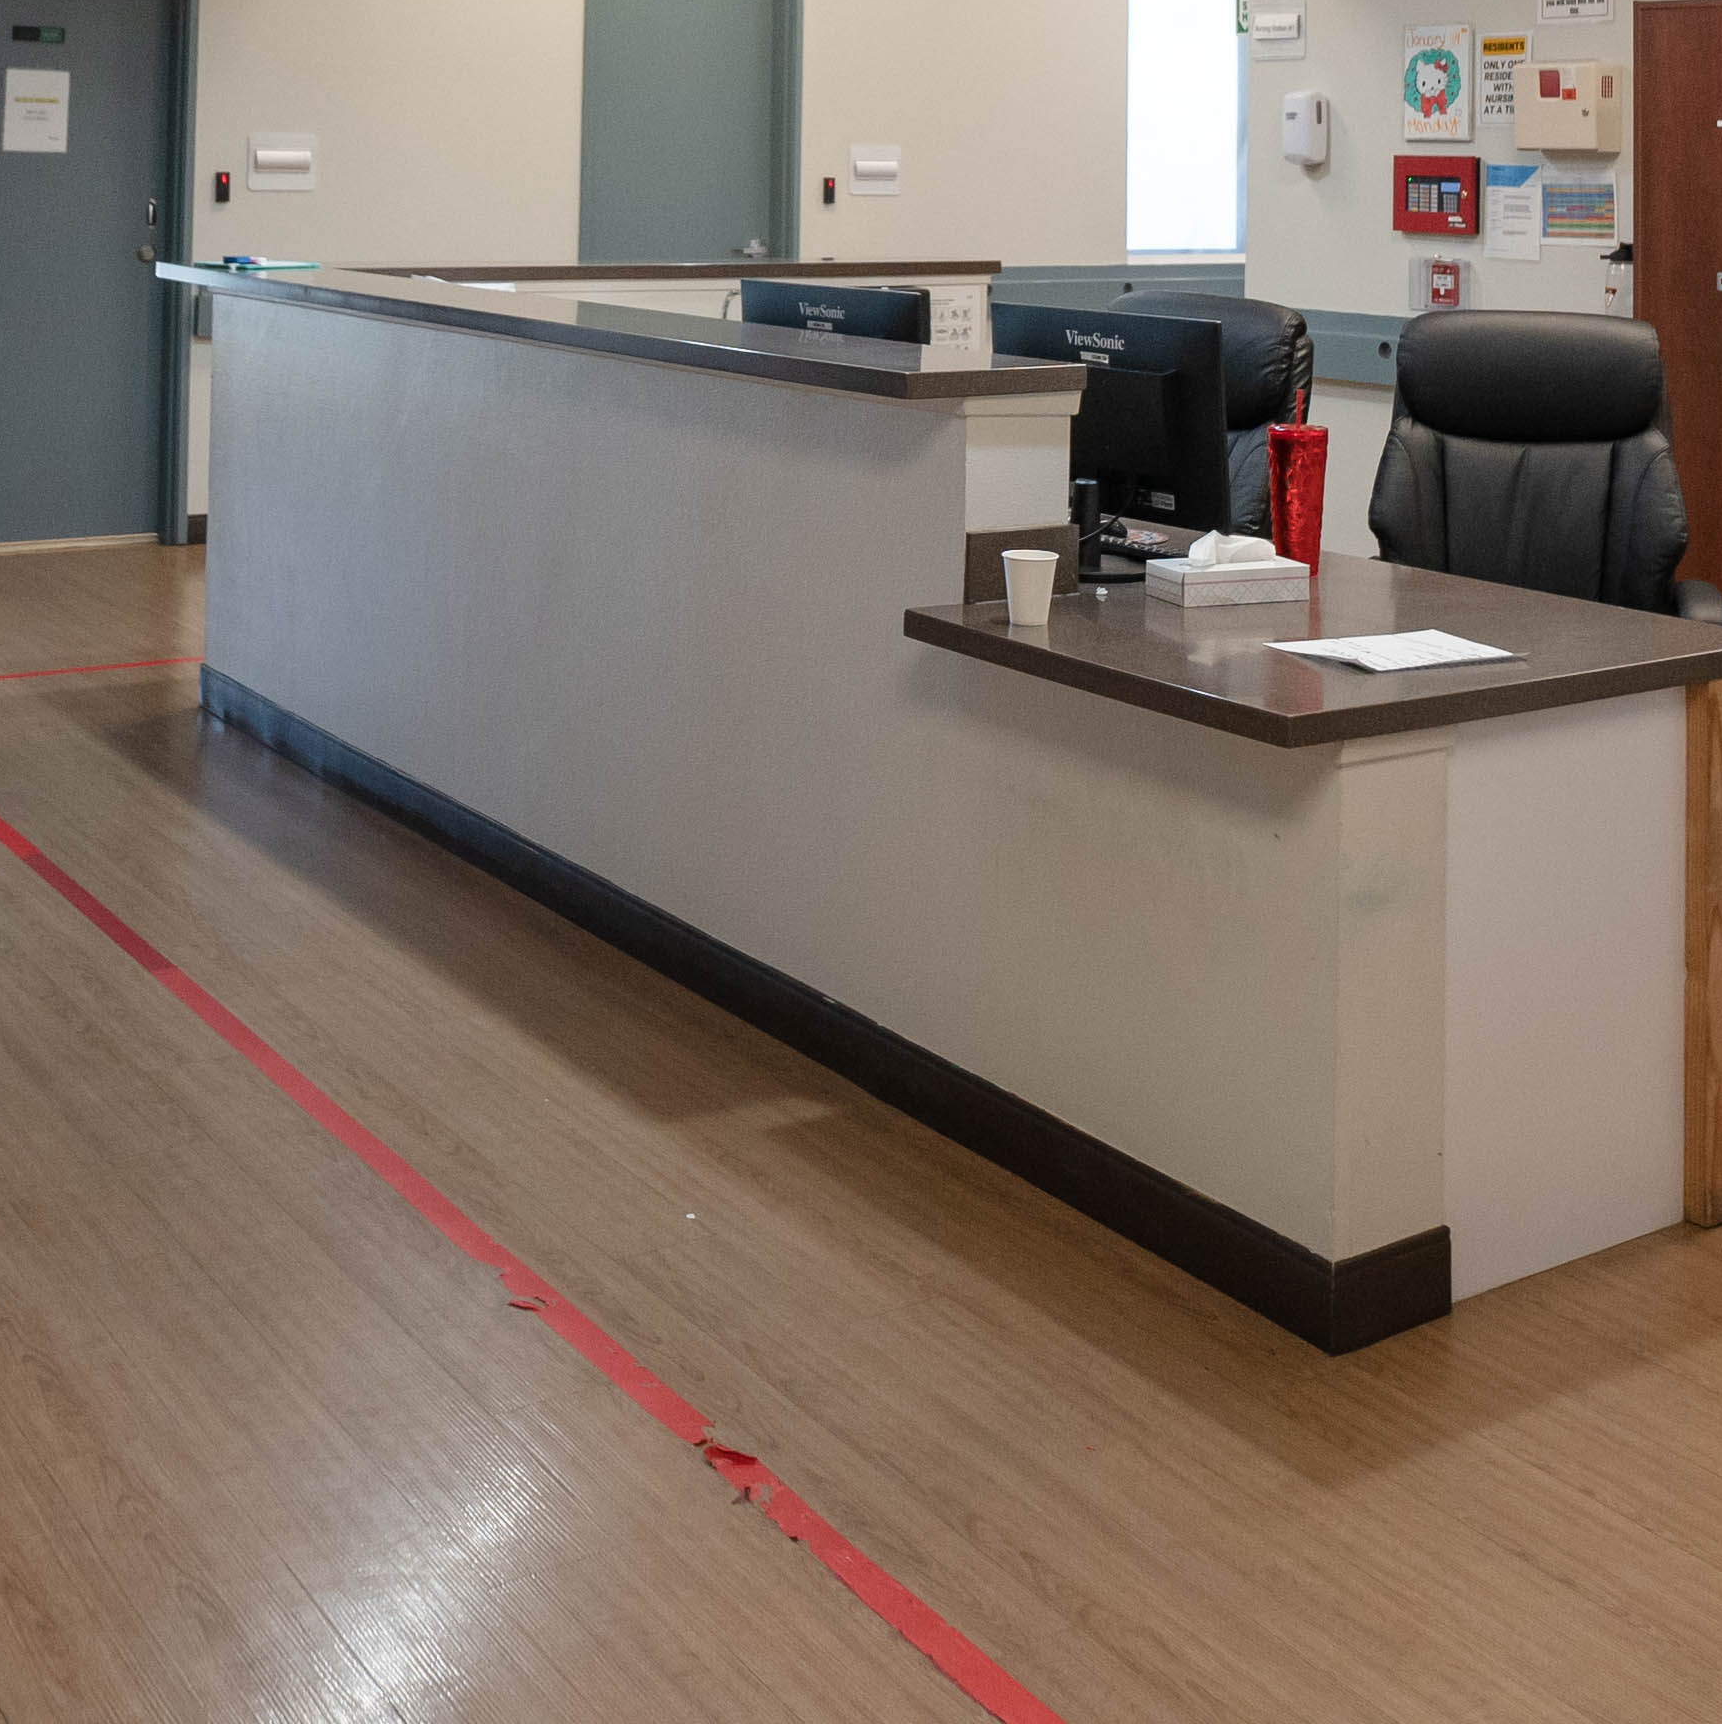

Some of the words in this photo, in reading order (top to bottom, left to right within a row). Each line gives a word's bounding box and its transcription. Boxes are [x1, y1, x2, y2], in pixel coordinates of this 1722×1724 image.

[1483, 40, 1525, 52] RESIDENTS
[1483, 60, 1506, 70] ONLY
[1484, 71, 1513, 82] RESIDE
[1483, 105, 1496, 115] AT
[1496, 105, 1503, 115] A
[798, 301, 846, 320] ViewSonic
[1065, 329, 1125, 351] ViewSonic
